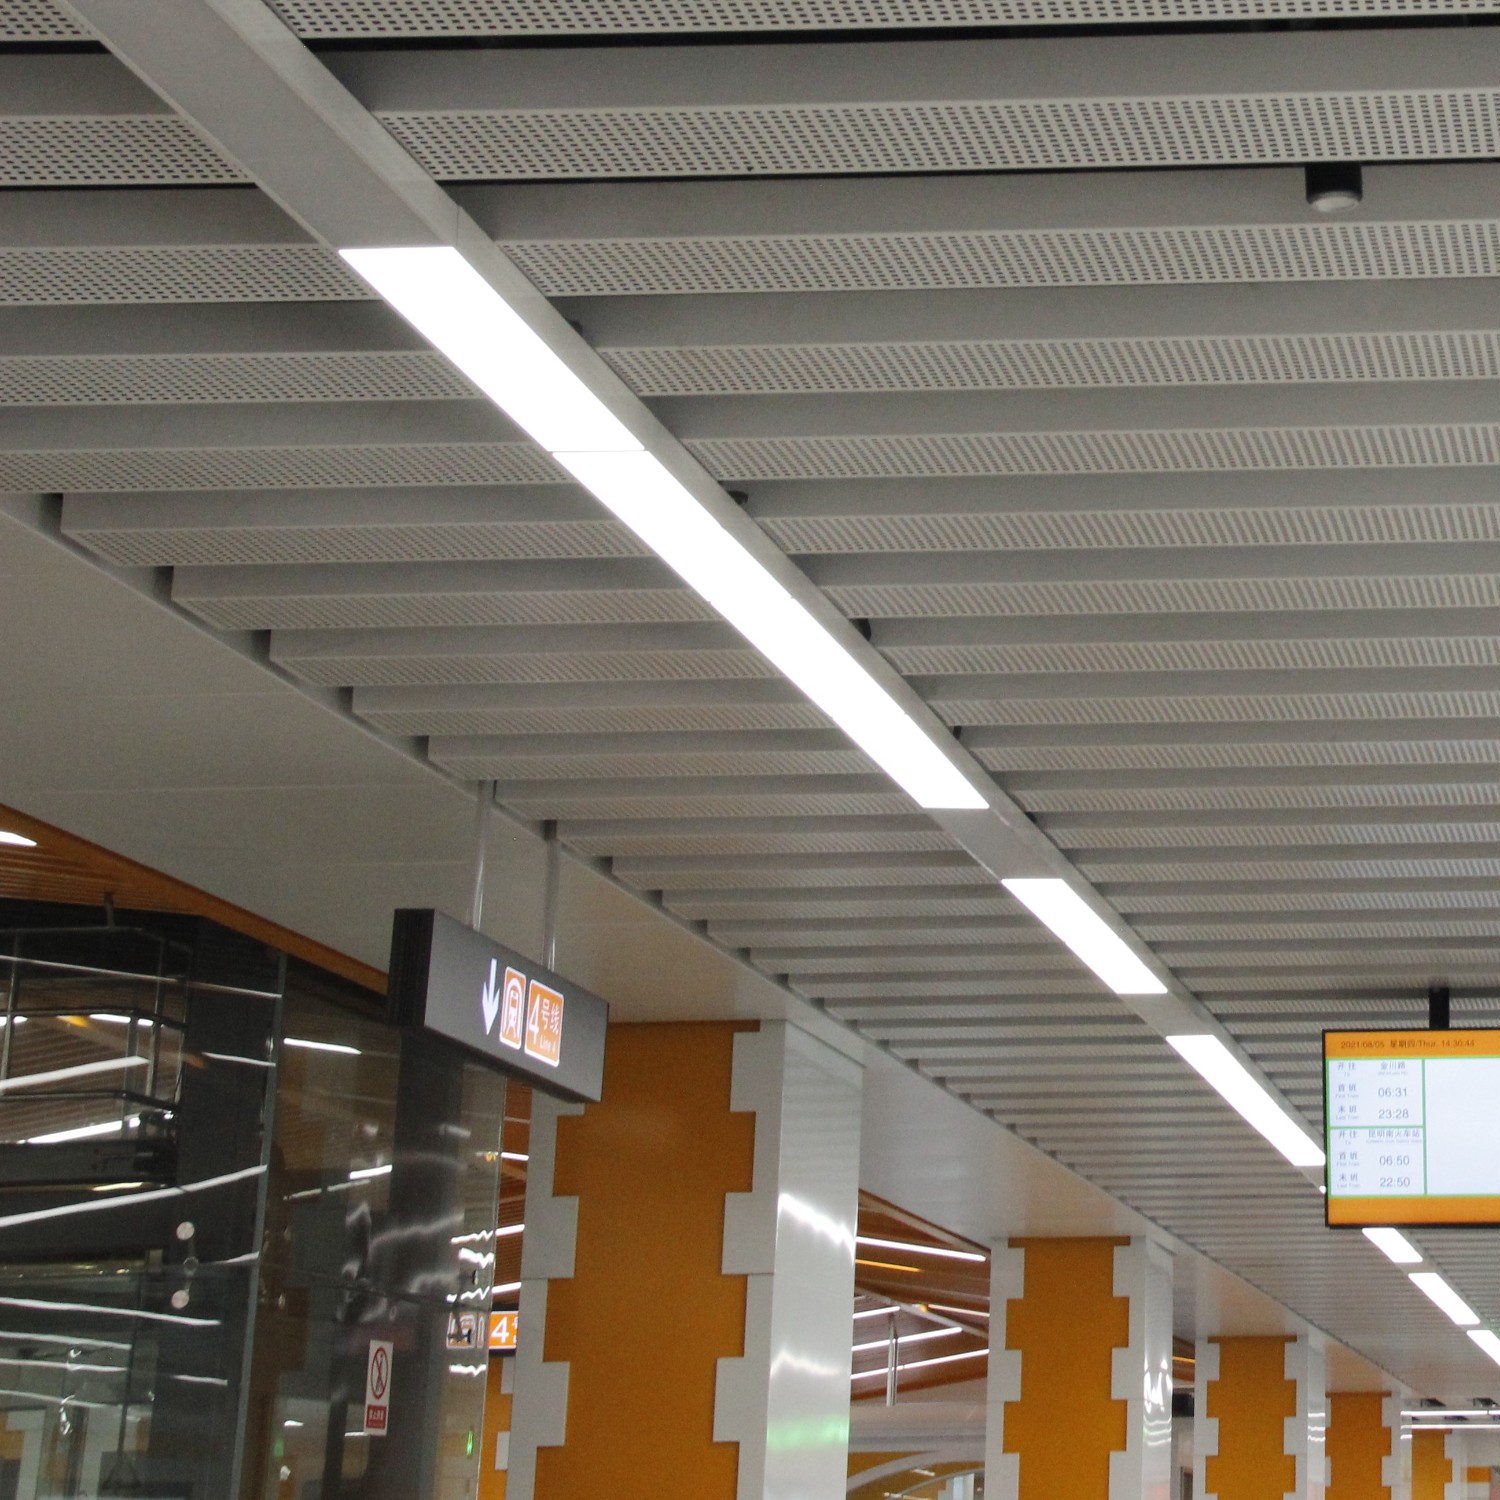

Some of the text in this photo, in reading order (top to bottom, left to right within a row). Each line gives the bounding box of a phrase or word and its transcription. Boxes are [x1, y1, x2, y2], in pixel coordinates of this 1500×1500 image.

[1341, 1041, 1385, 1049] 2021/08/05
[1378, 1087, 1408, 1098] 06:31
[1378, 1109, 1409, 1119] 23:28
[1368, 1129, 1420, 1138] 昆明南火车站
[1379, 1155, 1410, 1166] 06:50
[1380, 1177, 1411, 1187] 22:50
